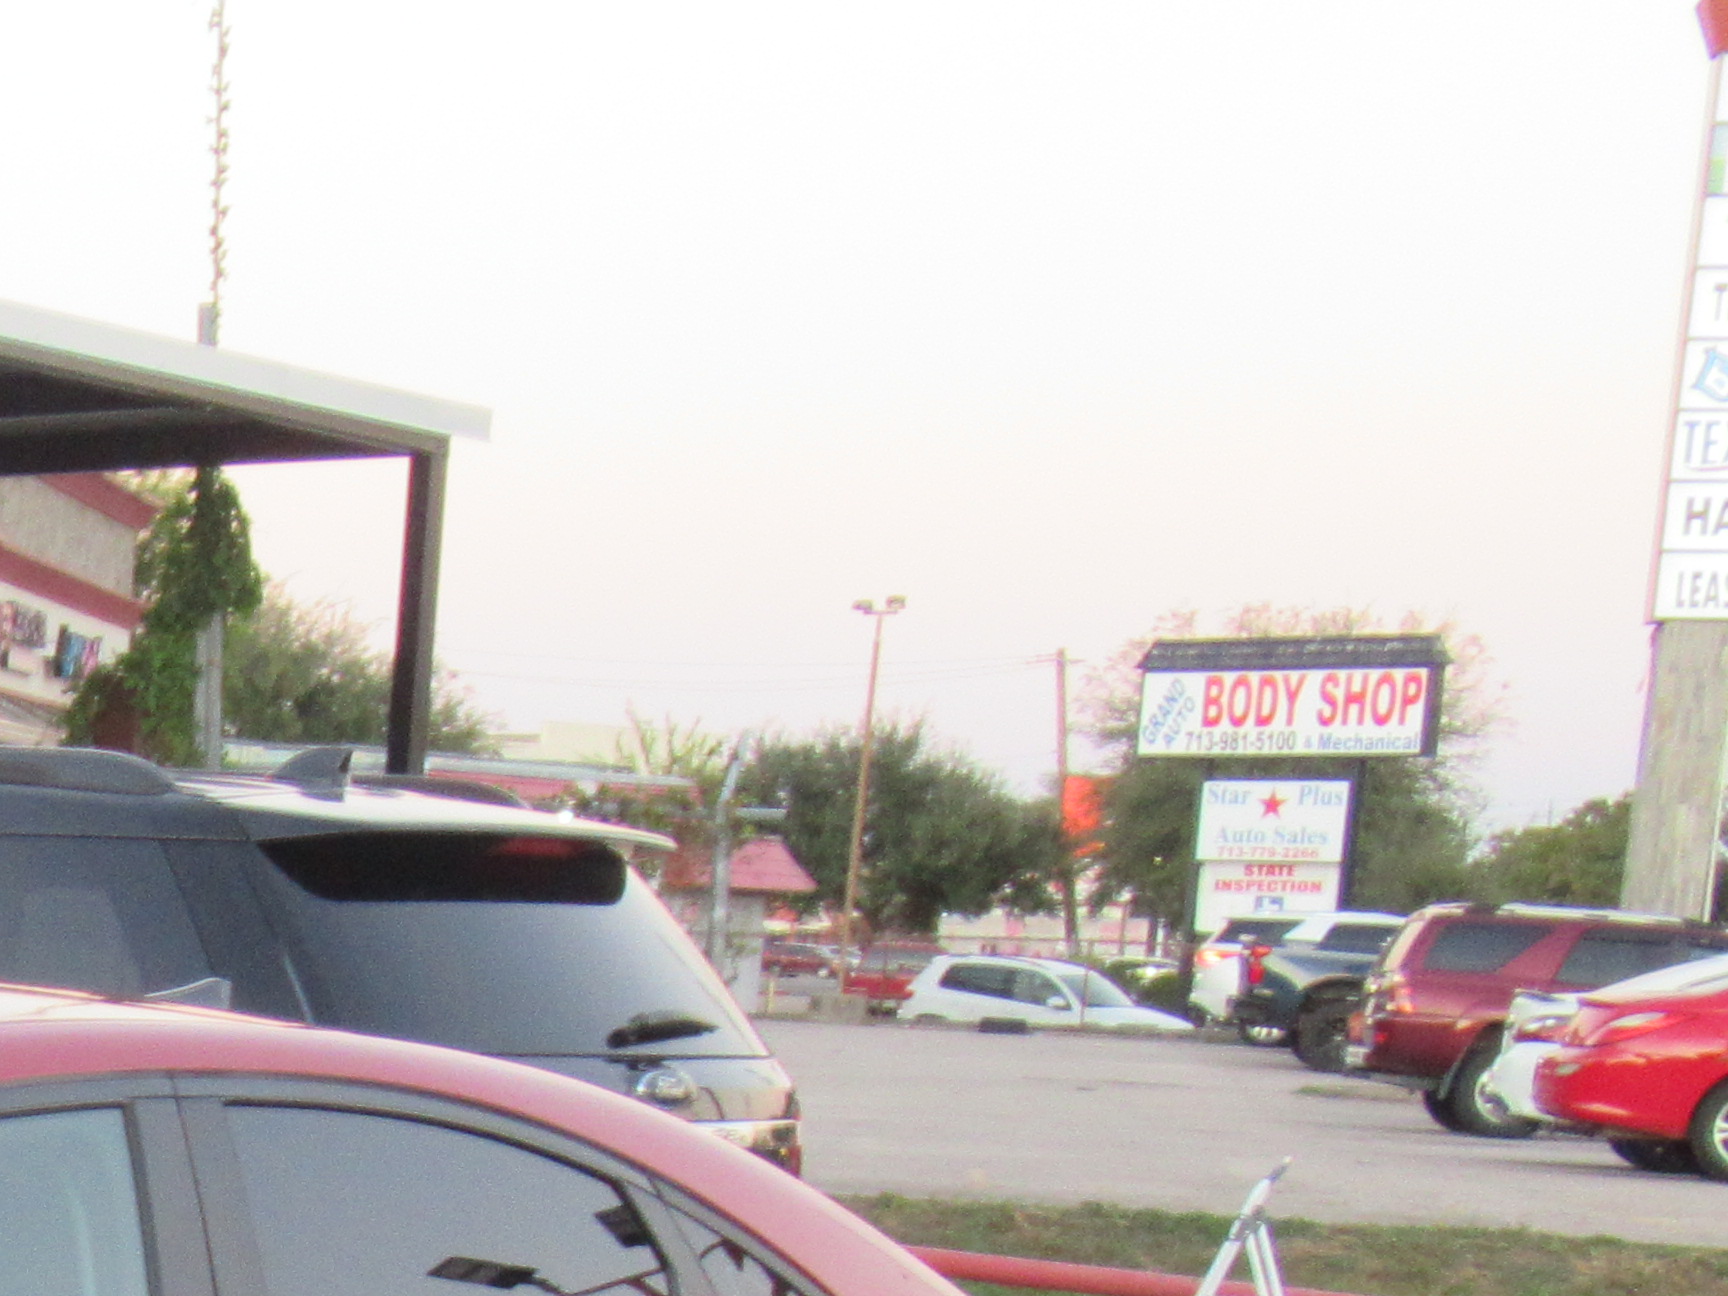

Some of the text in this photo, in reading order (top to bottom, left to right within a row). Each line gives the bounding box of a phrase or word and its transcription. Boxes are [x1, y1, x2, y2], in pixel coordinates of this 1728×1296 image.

[1684, 420, 1728, 465] TE
[1676, 571, 1728, 609] LEA
[1144, 677, 1186, 746] GRAND
[1201, 671, 1424, 728] BODY SHOP
[1163, 696, 1196, 747] AUTO
[1184, 731, 1297, 751] 713-981-5100
[1316, 732, 1421, 751] Mechanical
[1208, 781, 1345, 806] Star Plus
[1215, 826, 1329, 845] Auto Sales
[1215, 879, 1323, 893] INSPECTION
[1244, 864, 1296, 877] STATE
